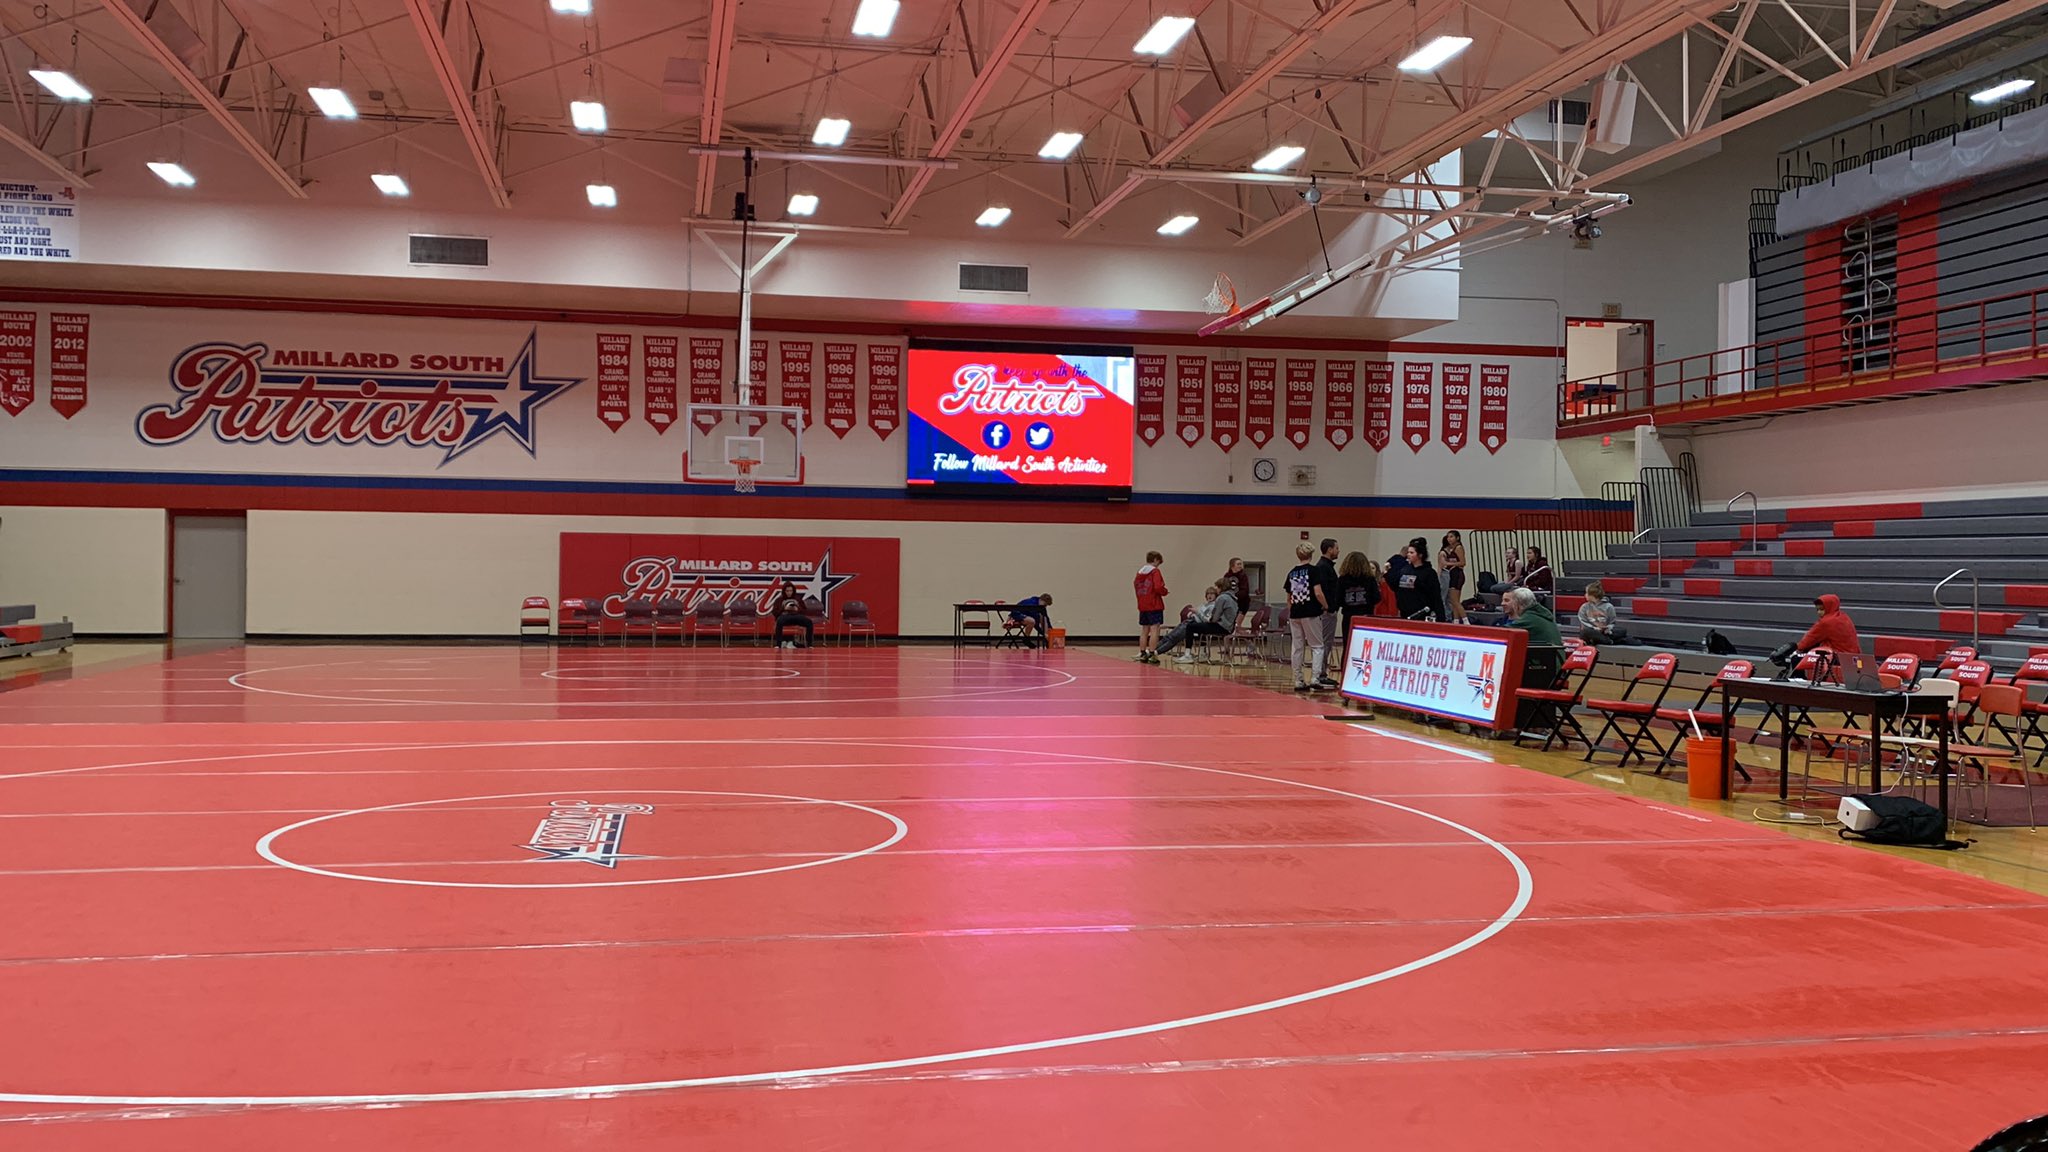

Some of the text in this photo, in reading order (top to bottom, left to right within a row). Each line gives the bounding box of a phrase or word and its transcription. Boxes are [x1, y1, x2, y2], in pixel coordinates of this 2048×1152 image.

[0, 205, 74, 216] RED AND THE WHITE.
[14, 237, 28, 245] AND
[14, 247, 27, 255] AND
[30, 248, 43, 256] THE
[45, 248, 71, 257] WHITE.
[0, 335, 32, 347] 2002
[54, 338, 84, 349] 2012
[600, 336, 629, 344] MILLARD
[646, 338, 675, 346] MILLARD
[650, 346, 672, 354] SOUTH
[273, 349, 505, 372] MILLARD SOUTH
[600, 355, 628, 366] 1984
[647, 357, 675, 368] 1988
[692, 358, 721, 370] 1989
[783, 362, 810, 372] 1995
[827, 364, 853, 374] 1996
[872, 365, 897, 376] 1996
[1214, 364, 1239, 372] MILLARD
[1406, 365, 1431, 373] MILLARD
[1139, 377, 1164, 388] 1940
[1179, 378, 1203, 389] 1951
[1249, 380, 1273, 390] 1954
[1288, 381, 1313, 391] 1958
[1328, 382, 1353, 392] 1966
[939, 363, 1093, 416] Patriots
[1214, 383, 1239, 393] 1953
[1367, 383, 1391, 393] 1975
[1406, 384, 1430, 394] 1976
[1445, 385, 1468, 395] 1978
[1483, 386, 1507, 396] 1980
[135, 342, 467, 446] Patriots
[1215, 420, 1237, 428] BASEBALL
[1407, 420, 1428, 428] BASEBALL
[933, 453, 1108, 474] Follow Millard South Activities
[680, 559, 814, 572] MILLARD SOUTH
[1376, 641, 1467, 672] MILLARD SOUTH
[1723, 664, 1747, 672] MILLARD
[1381, 665, 1449, 700] PATRIOTS
